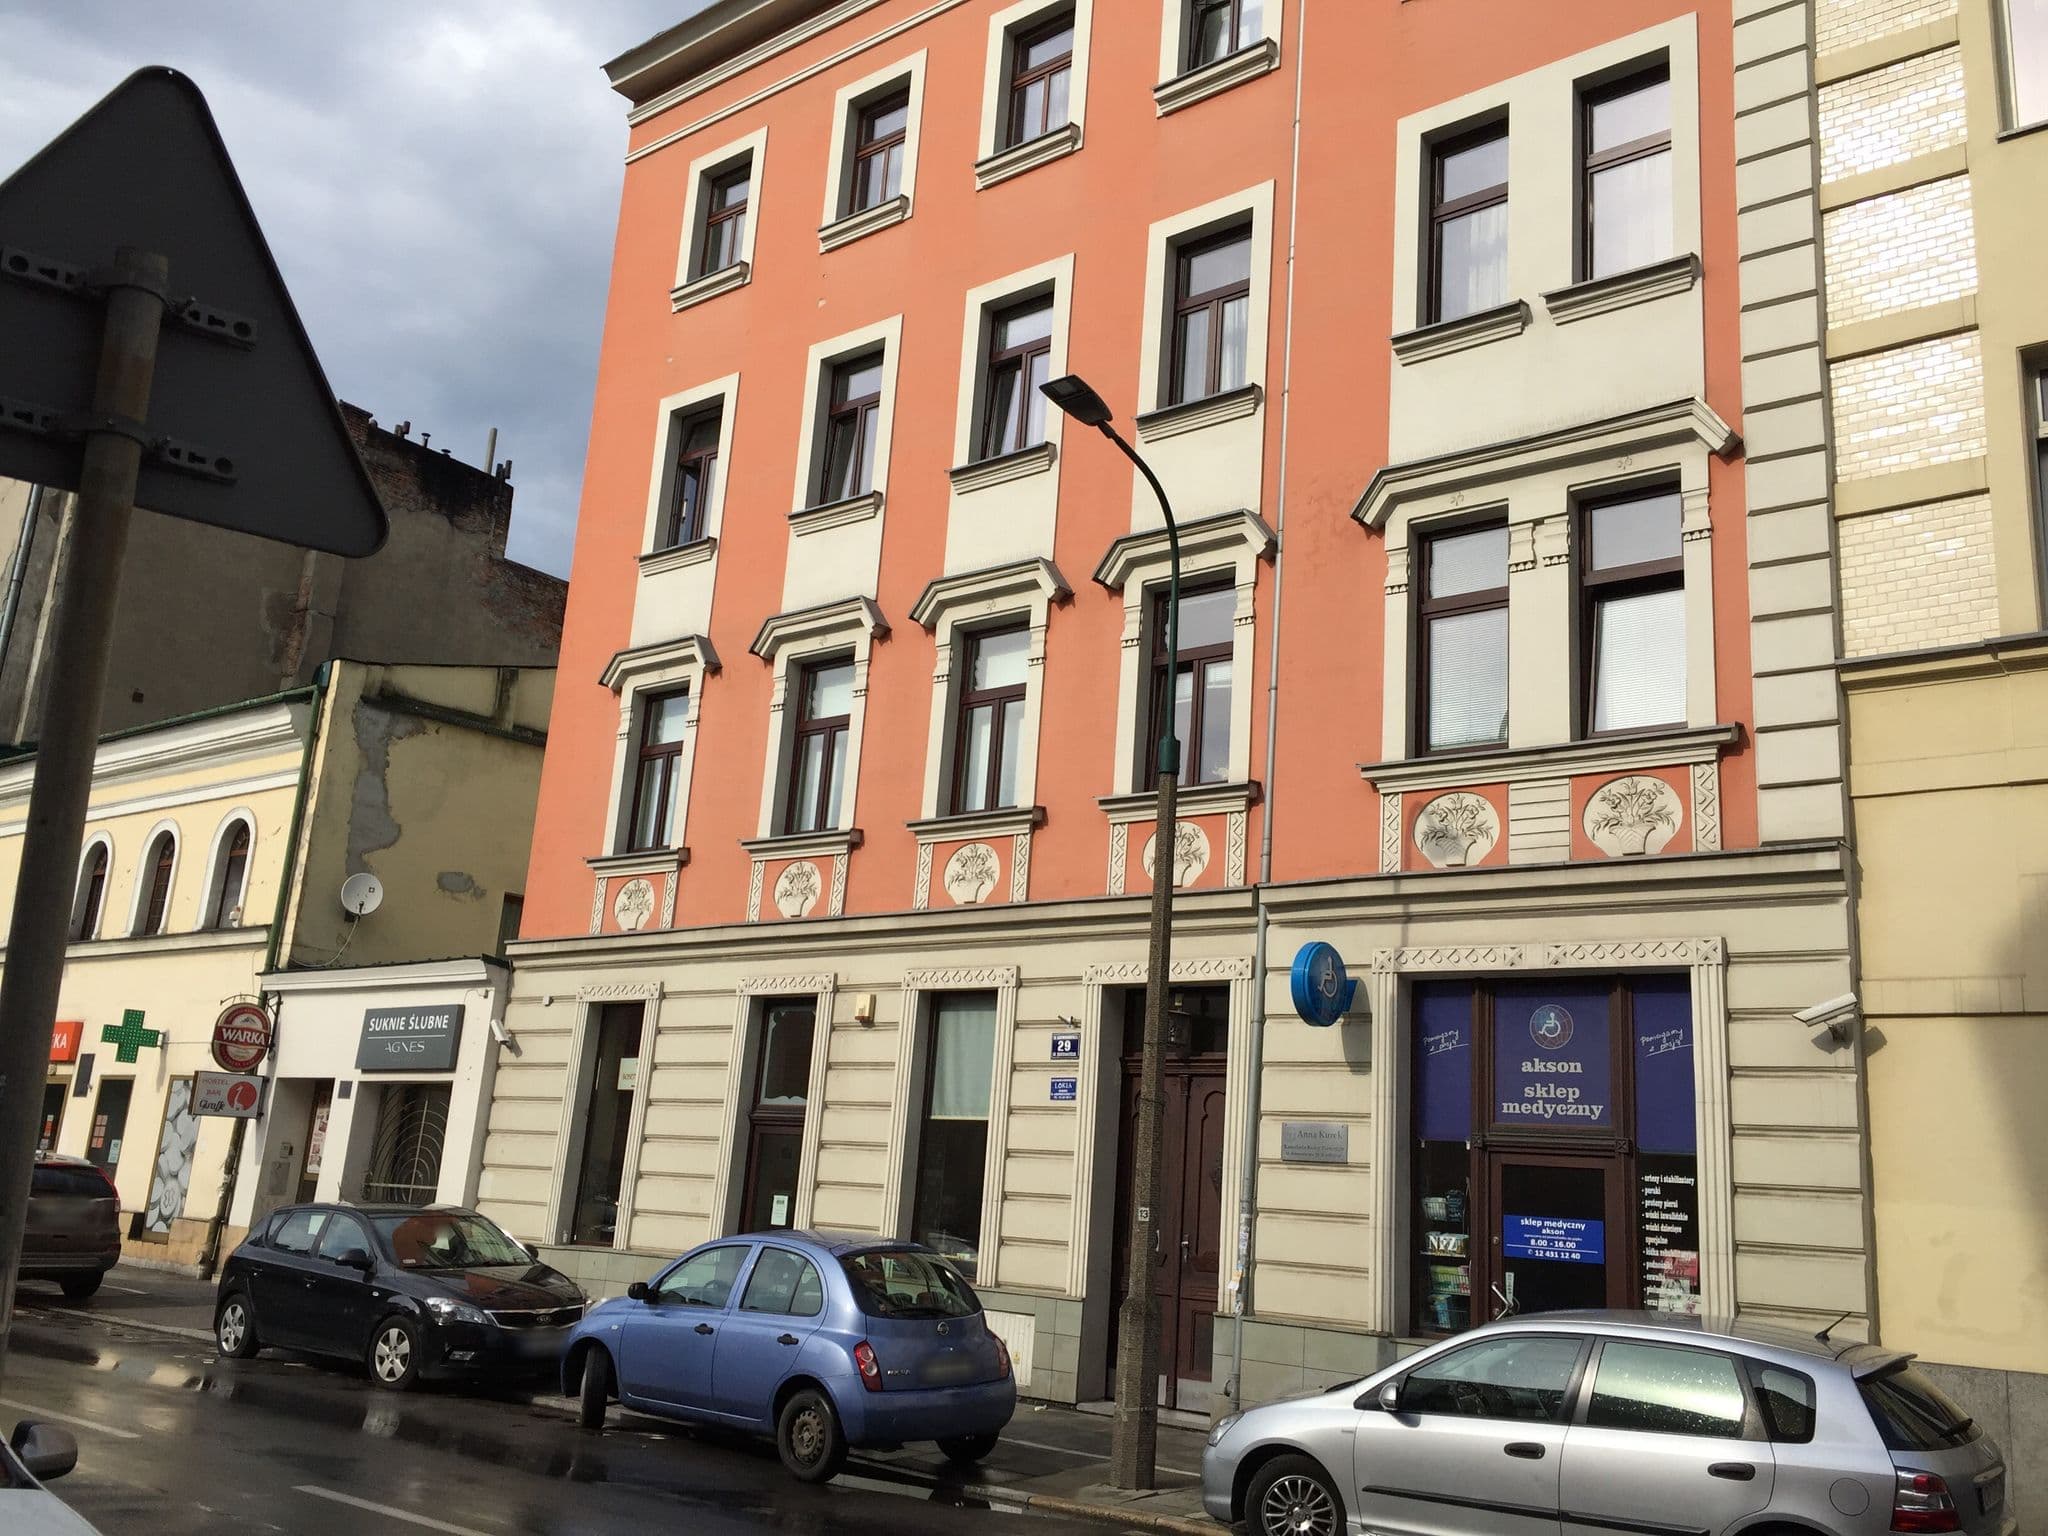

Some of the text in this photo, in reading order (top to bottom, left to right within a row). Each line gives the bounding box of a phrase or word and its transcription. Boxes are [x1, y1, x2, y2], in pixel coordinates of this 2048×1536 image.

[368, 1013, 450, 1032] SUKNIE ŚLUBNE
[51, 1032, 68, 1049] KA
[222, 1027, 265, 1046] WARKA
[384, 1040, 425, 1053] AGNES
[1057, 1039, 1072, 1052] 29
[1521, 1057, 1583, 1073] akson
[1524, 1083, 1580, 1103] sklep
[1502, 1100, 1604, 1120] medyczny
[1520, 1218, 1586, 1231] sklep medyczny
[1554, 1241, 1577, 1249] 16.00
